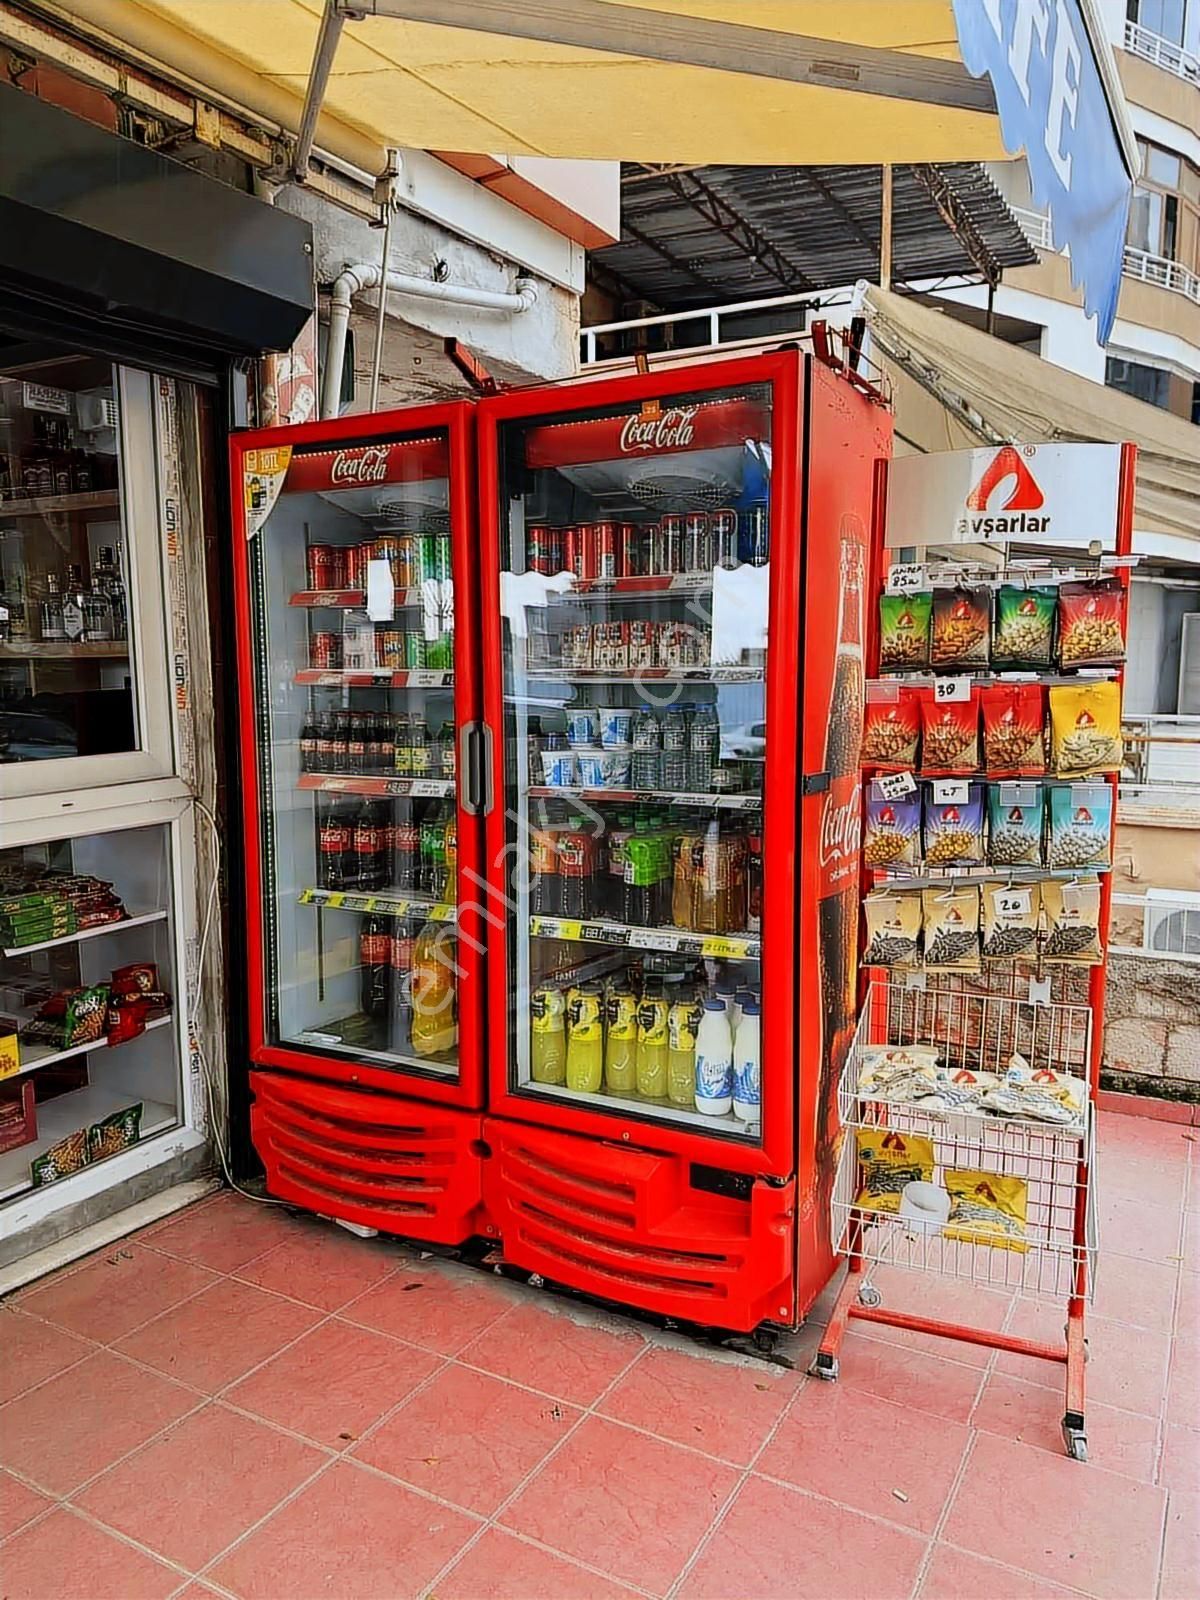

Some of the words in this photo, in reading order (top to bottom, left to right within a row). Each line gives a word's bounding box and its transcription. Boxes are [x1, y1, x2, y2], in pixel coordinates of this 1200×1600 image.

[619, 407, 699, 452] Coca-Cola
[331, 447, 391, 484] Coca-Cola
[959, 513, 1051, 539] avşarlar
